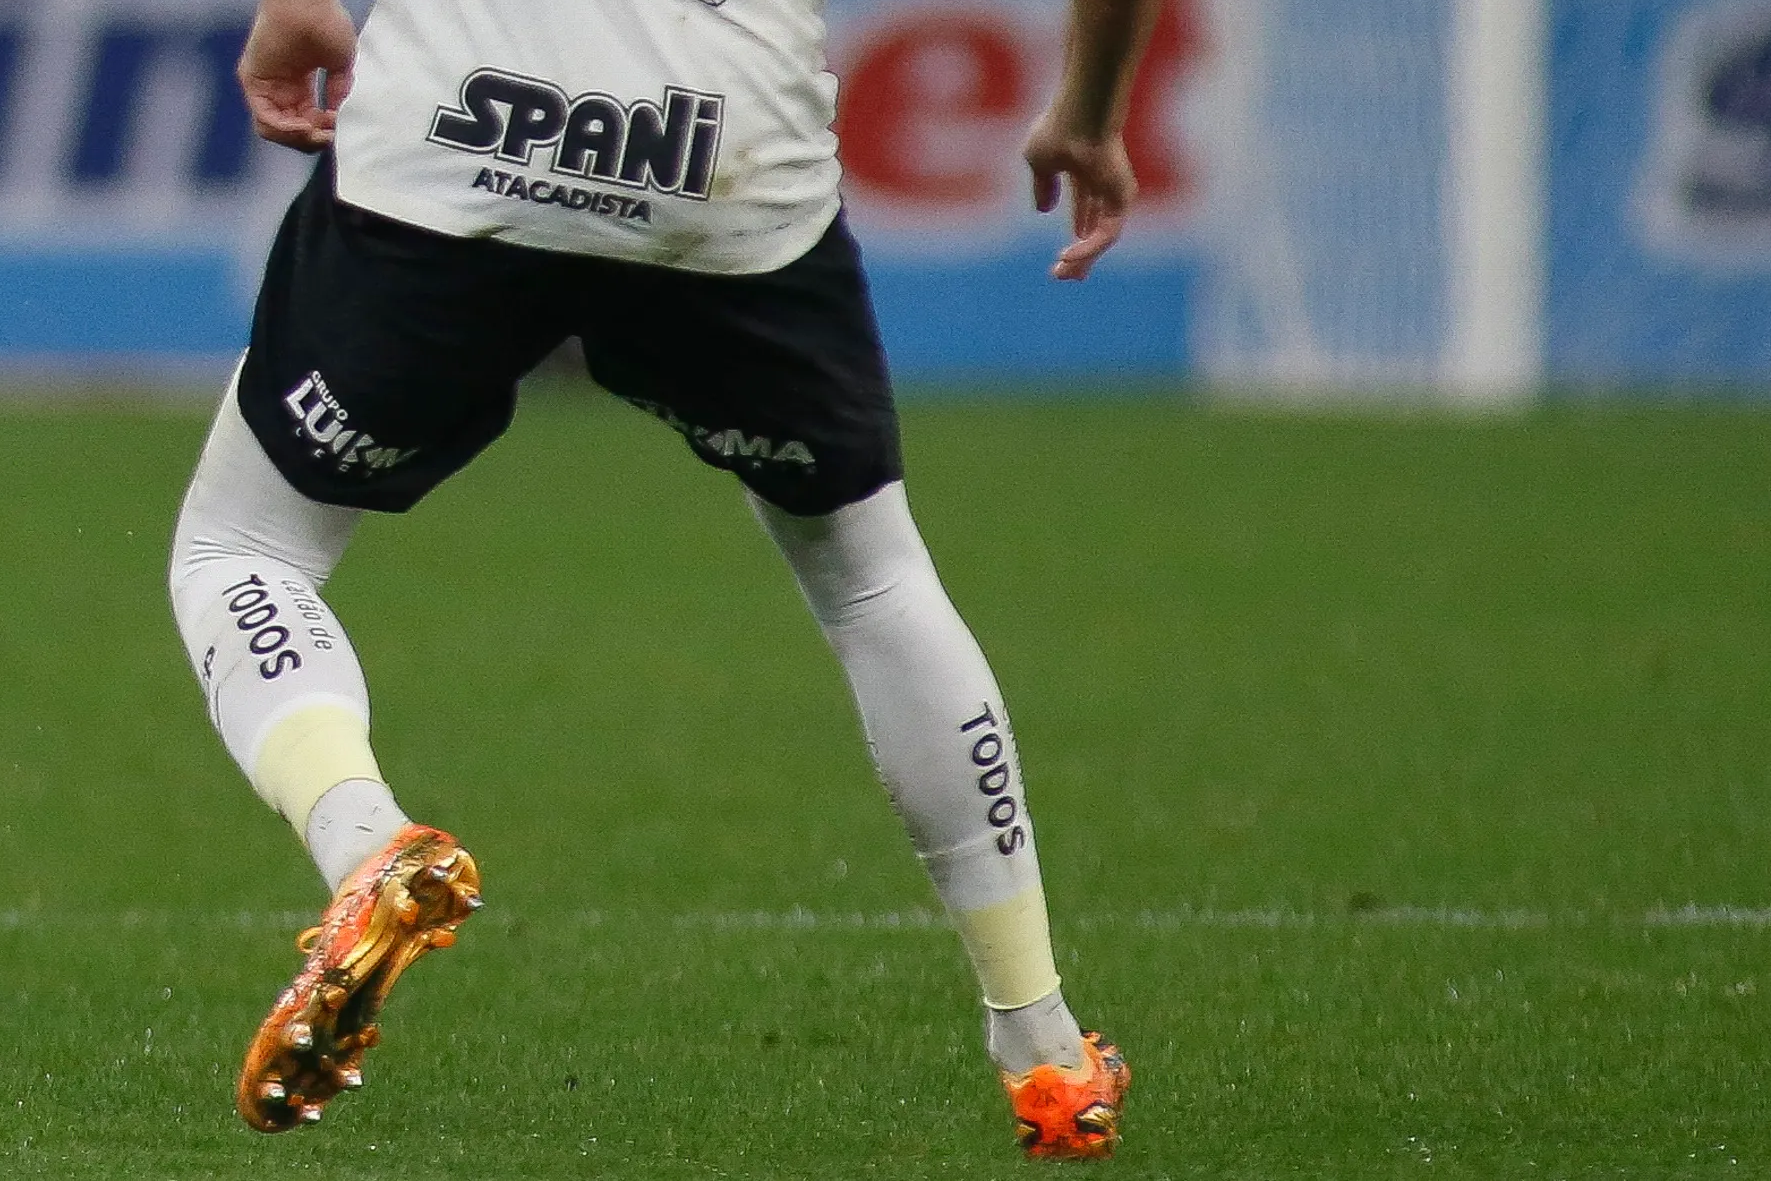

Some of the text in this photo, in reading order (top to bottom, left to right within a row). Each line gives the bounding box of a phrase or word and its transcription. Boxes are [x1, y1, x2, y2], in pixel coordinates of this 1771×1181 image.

[471, 166, 654, 223] ATACADISTA
[311, 370, 349, 421] GRUPO
[221, 573, 303, 680] TODOS
[308, 626, 337, 651] de
[959, 700, 1025, 856] TODOS
